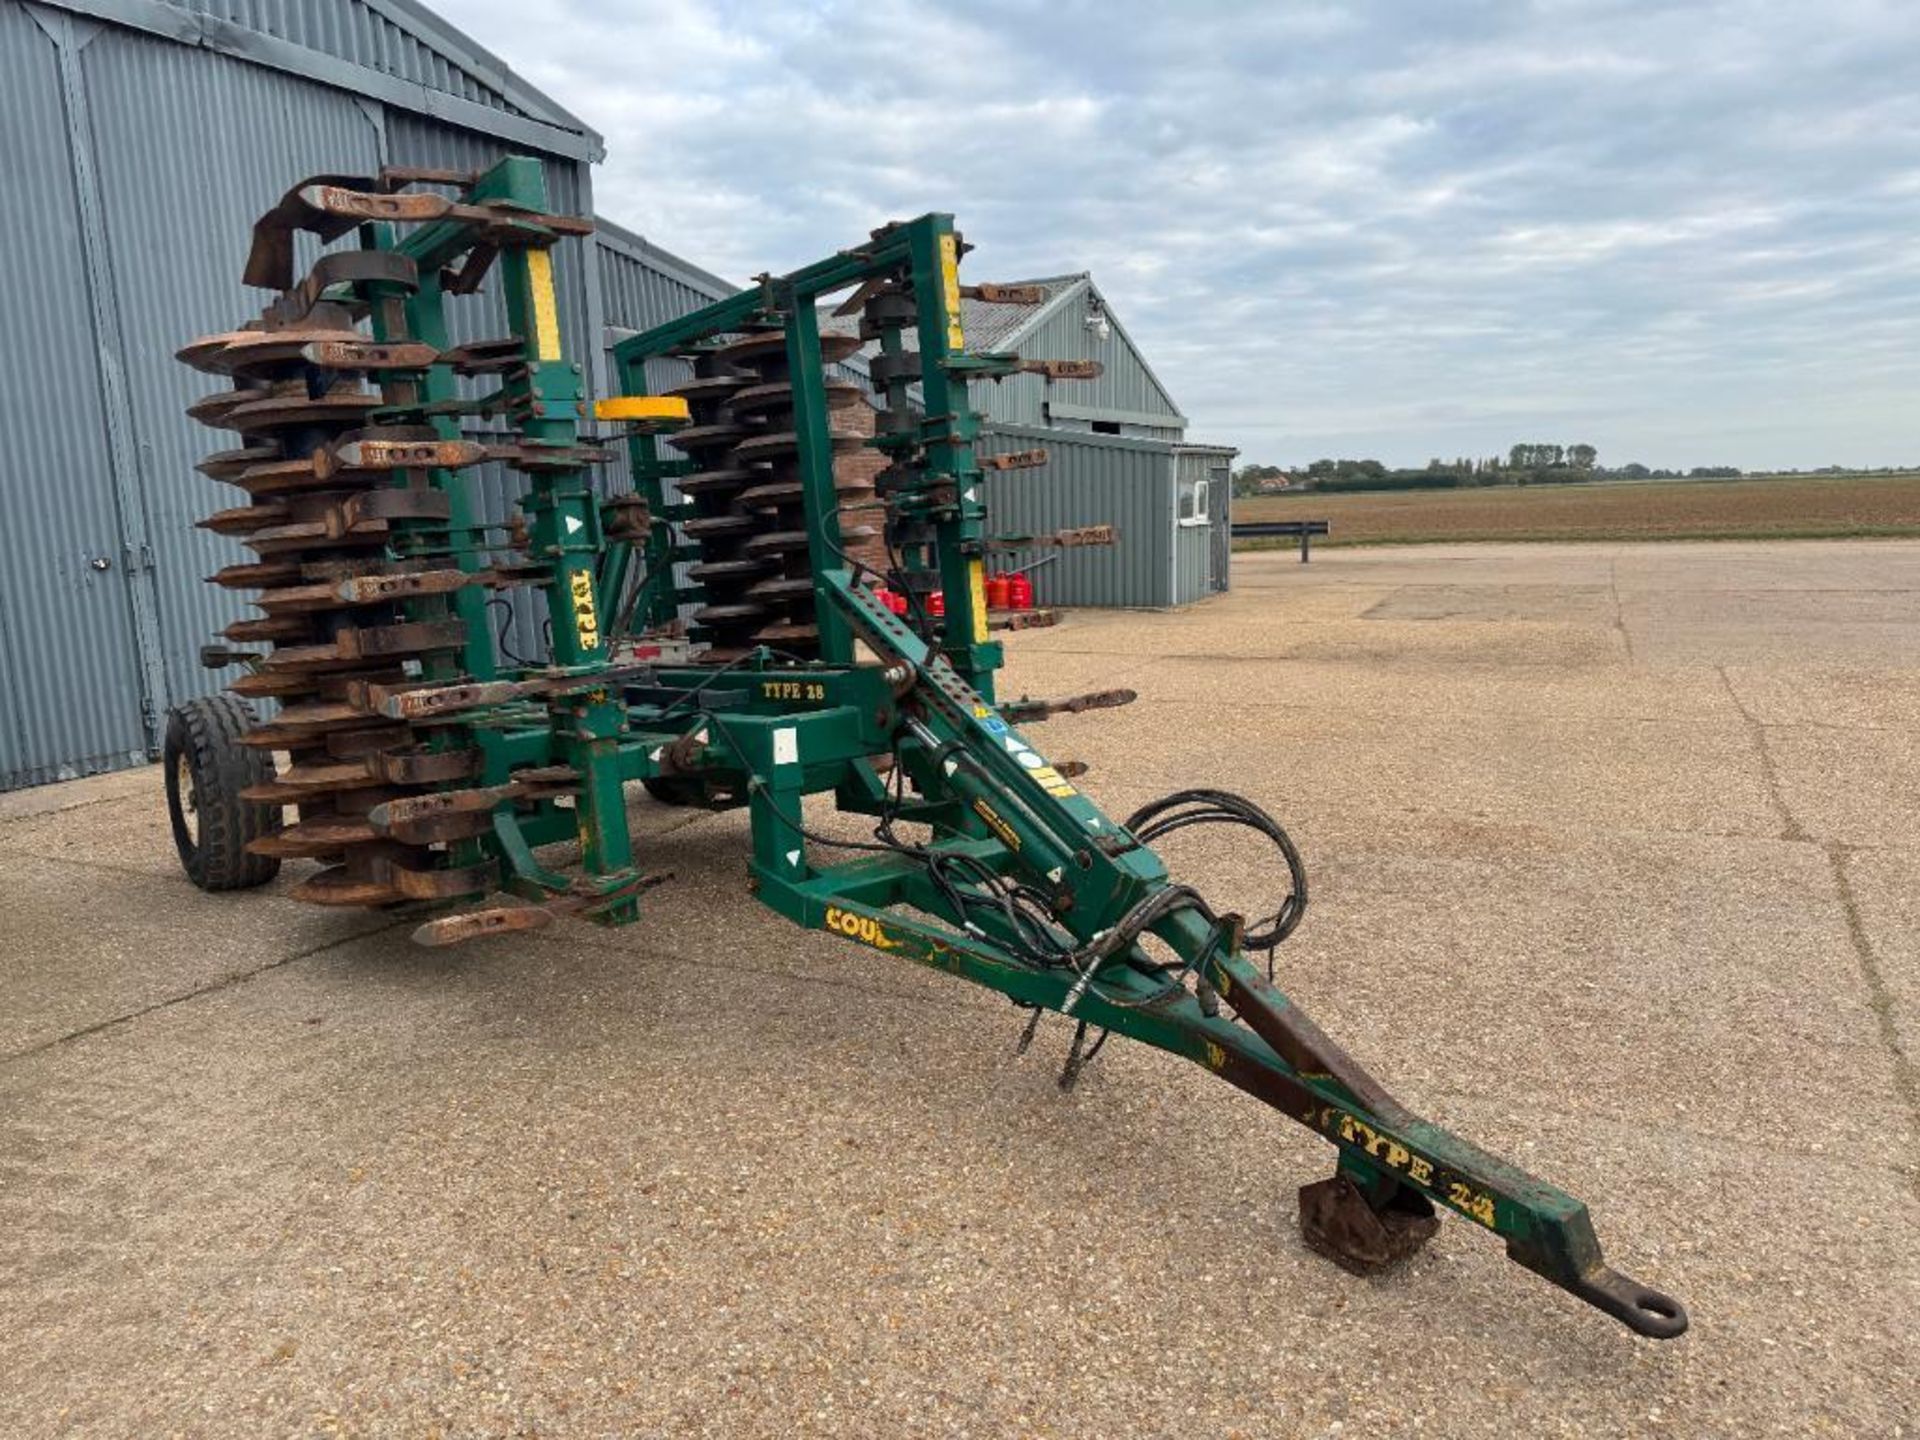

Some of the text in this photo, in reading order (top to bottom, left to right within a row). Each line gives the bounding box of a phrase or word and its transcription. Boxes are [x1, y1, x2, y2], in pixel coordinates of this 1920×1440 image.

[570, 569, 599, 650] TYPE
[763, 682, 824, 700] TYPE 28
[1339, 1114, 1434, 1187] TYPE
